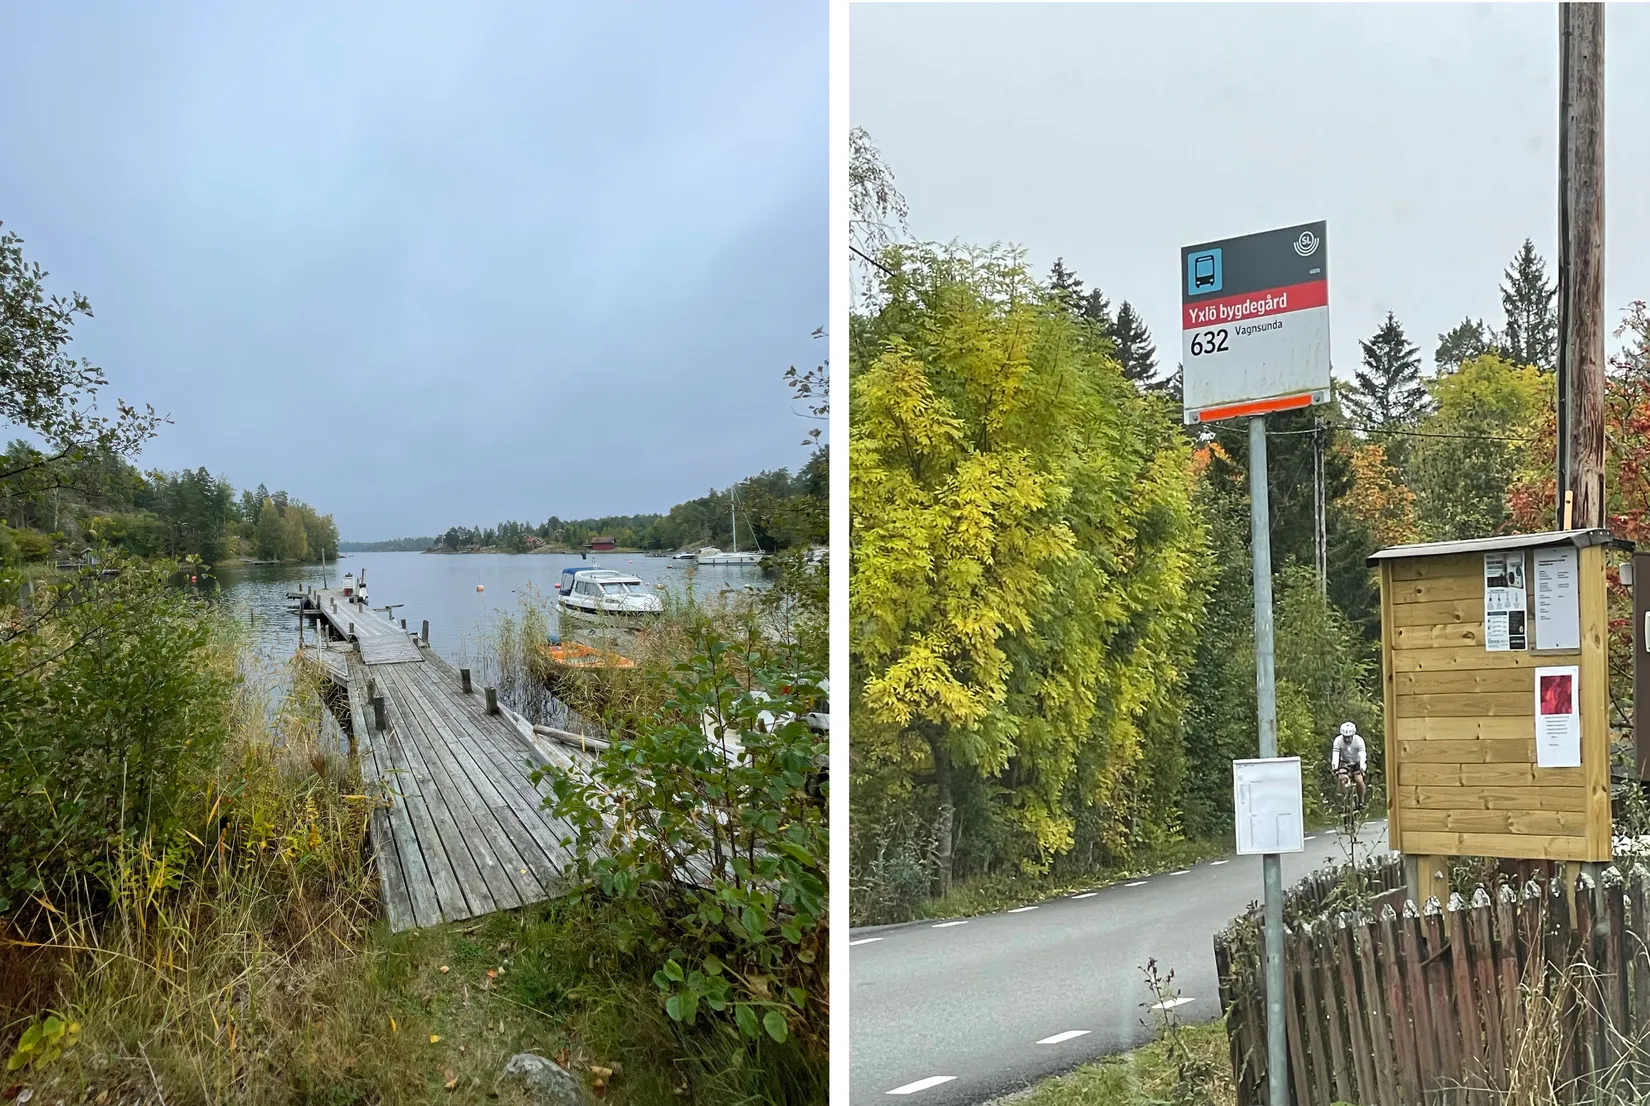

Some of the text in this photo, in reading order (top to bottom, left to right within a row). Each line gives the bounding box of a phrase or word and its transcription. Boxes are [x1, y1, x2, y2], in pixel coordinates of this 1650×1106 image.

[1301, 236, 1312, 245] SL
[1189, 292, 1287, 324] Yxlö bygdegård
[1190, 320, 1283, 357] 632 Vagnsunda
